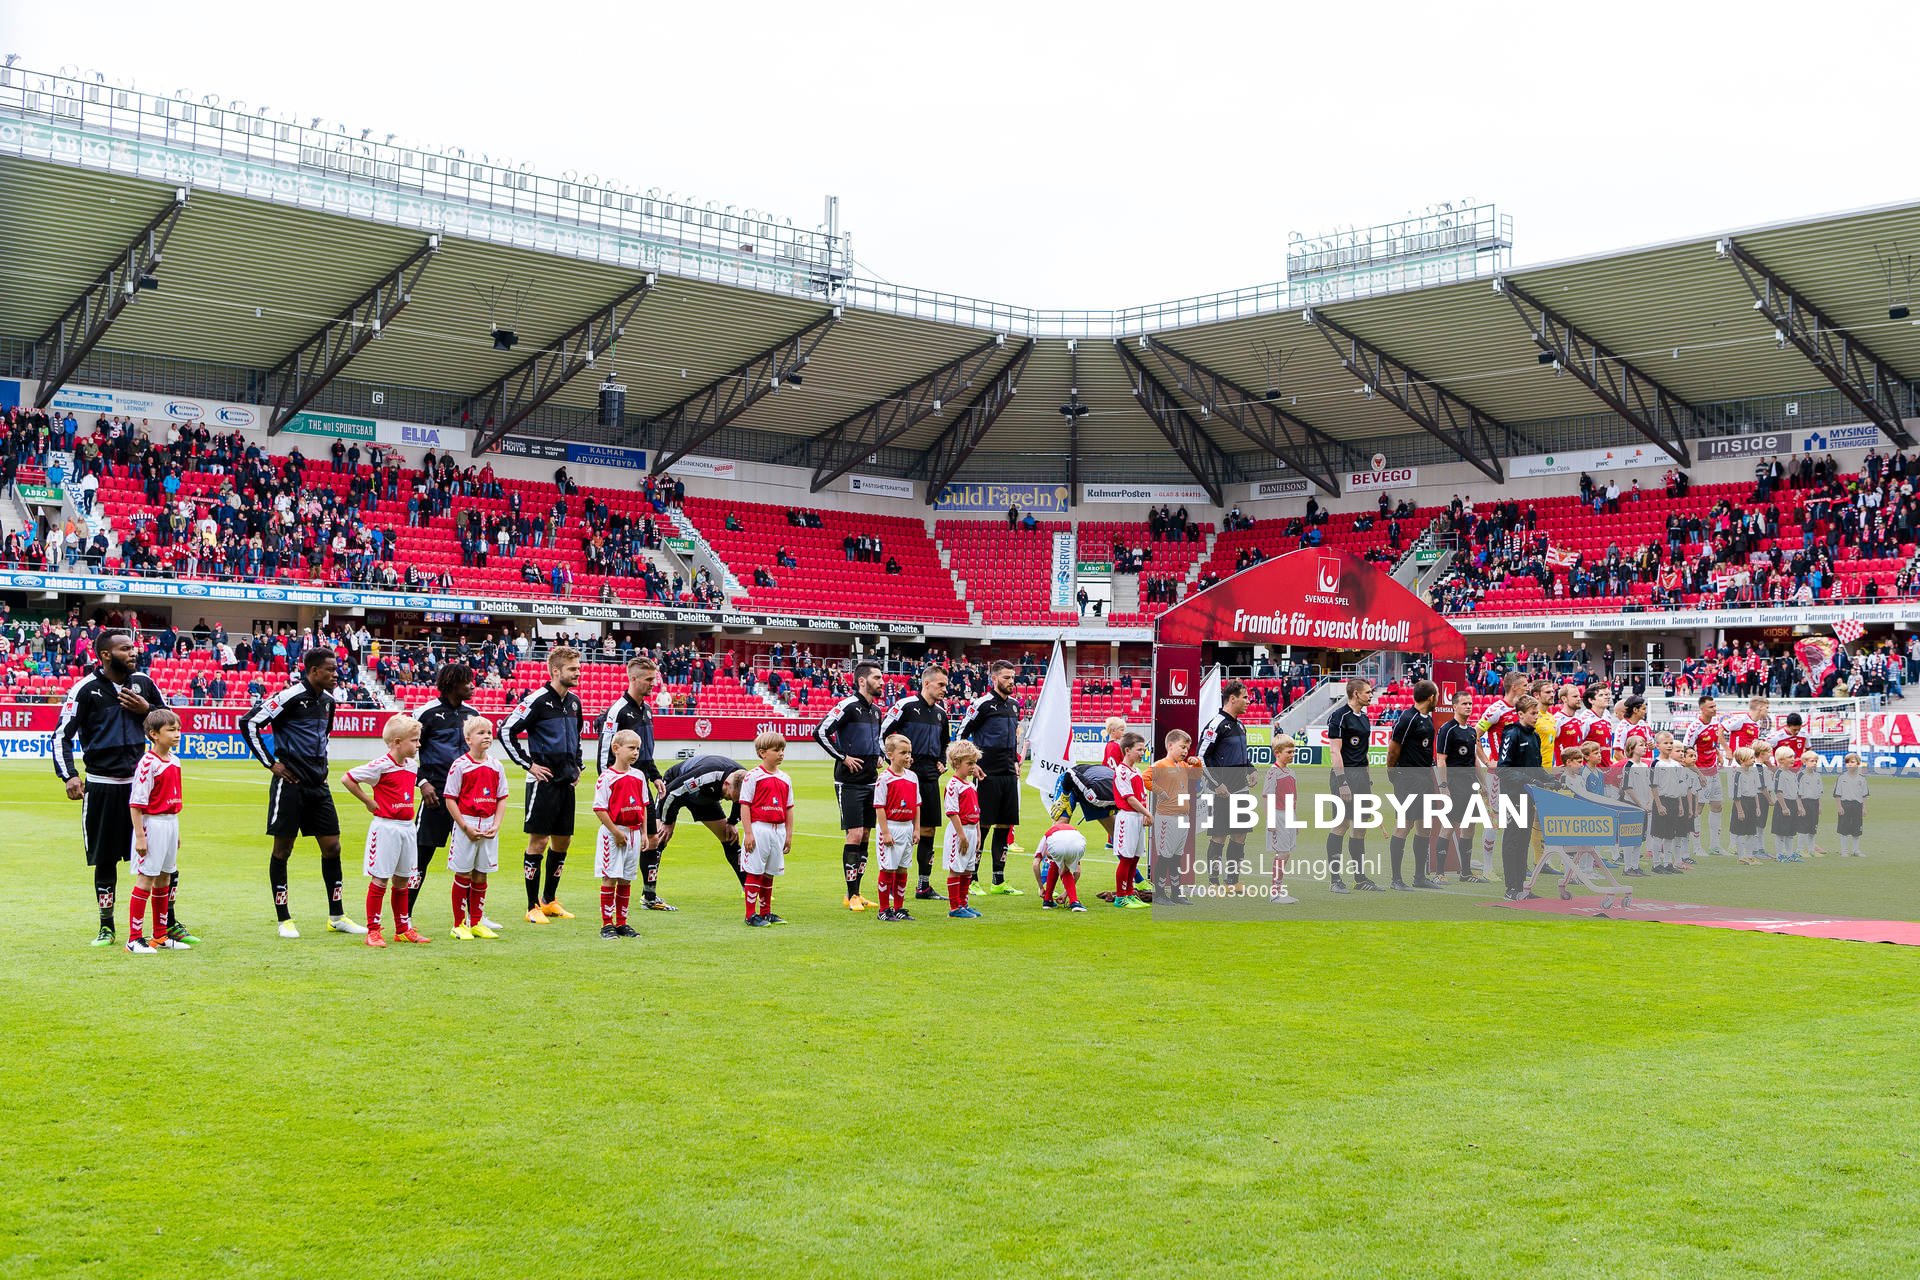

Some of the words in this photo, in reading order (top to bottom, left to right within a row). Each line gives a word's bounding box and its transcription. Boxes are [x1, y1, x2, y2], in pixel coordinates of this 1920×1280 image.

[373, 393, 382, 403] G
[308, 419, 322, 430] THE
[335, 422, 374, 435] SPORTSBAR
[1830, 426, 1878, 438] MYSINGE
[401, 426, 440, 444] ELIA
[1711, 436, 1778, 454] inside
[1830, 438, 1879, 449] STENHUGGERI
[589, 447, 625, 457] KALMAR
[1352, 469, 1412, 485] BEVEGO
[1261, 482, 1306, 493] DANIELSONS
[935, 486, 983, 506] Guld
[987, 486, 1052, 511] Fågeln
[1087, 489, 1151, 498] KalmarPosten
[1059, 535, 1071, 570] SERVICE
[17, 577, 39, 587] Ford
[101, 581, 122, 591] Ford
[183, 585, 205, 595] Ford
[262, 589, 281, 599] Ford
[338, 594, 356, 604] Ford
[409, 598, 426, 607] Ford
[1304, 594, 1334, 605] SVENSKA
[1335, 596, 1349, 606] SPEL
[480, 600, 521, 612] Deloitte.
[532, 603, 572, 615] Deloitte.
[394, 611, 419, 620] KIOSK
[582, 606, 620, 618] Deloitte.
[630, 609, 667, 620] Deloitte.
[677, 612, 713, 622] Deloitte.
[1759, 613, 1798, 622] Barometern
[1805, 612, 1845, 621] Barometern
[1852, 610, 1894, 620] Barometern
[722, 614, 757, 625] Deloitte.
[766, 617, 800, 628] Deloitte.
[808, 619, 841, 630] Deloitte.
[1550, 619, 1584, 628] Barometern
[1590, 618, 1625, 627] Barometern
[1630, 617, 1665, 627] Barometern
[1672, 616, 1709, 625] Barometern
[1715, 614, 1753, 624] Barometern
[849, 621, 881, 632] Deloitte.
[889, 623, 920, 634] Deloitte.
[1233, 609, 1287, 635] Framåt
[1289, 611, 1313, 637] för
[1313, 617, 1359, 640] svensk
[1361, 617, 1410, 643] fotboll!
[1477, 621, 1508, 631] Barometern
[1512, 620, 1545, 630] Barometern
[1763, 628, 1790, 636] KIOSK
[1159, 697, 1184, 705] SVENSKA
[16, 711, 33, 728] FF
[193, 712, 232, 730] STÄLL
[332, 716, 359, 732] MAR
[362, 717, 376, 732] FF
[757, 721, 783, 736] STÄLL
[785, 724, 797, 736] ER
[799, 724, 816, 737] UPP
[184, 735, 245, 759] Fågeln
[1040, 759, 1068, 776] SVEN
[1817, 754, 1920, 775] MCA
[1547, 819, 1570, 833] CITY
[1572, 819, 1610, 833] GROSS
[1620, 826, 1630, 835] CITY
[1630, 825, 1642, 834] GROSS
